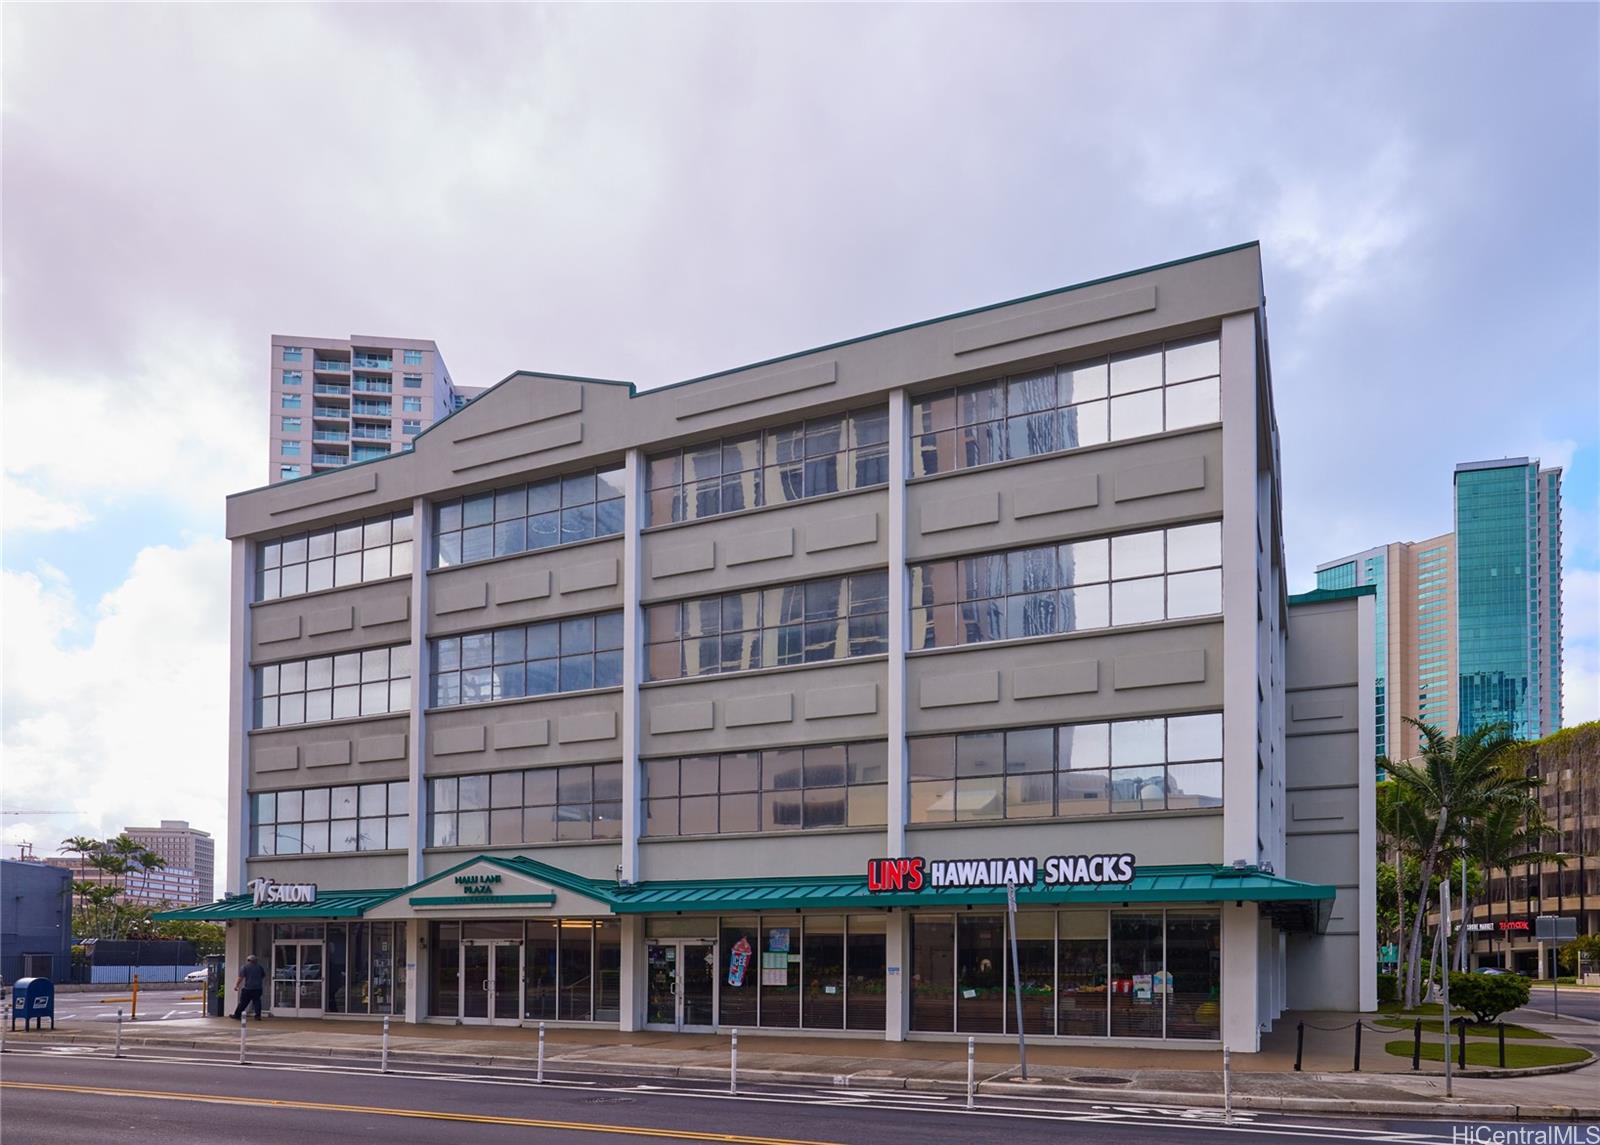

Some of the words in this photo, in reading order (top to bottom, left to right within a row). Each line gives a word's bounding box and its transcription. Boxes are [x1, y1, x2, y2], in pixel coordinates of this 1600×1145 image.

[867, 860, 922, 890] LIN'S
[931, 861, 1034, 887] HAWAIIAN
[1045, 856, 1133, 883] SNACKS
[268, 885, 315, 902] SALON
[464, 885, 493, 894] PLAZA
